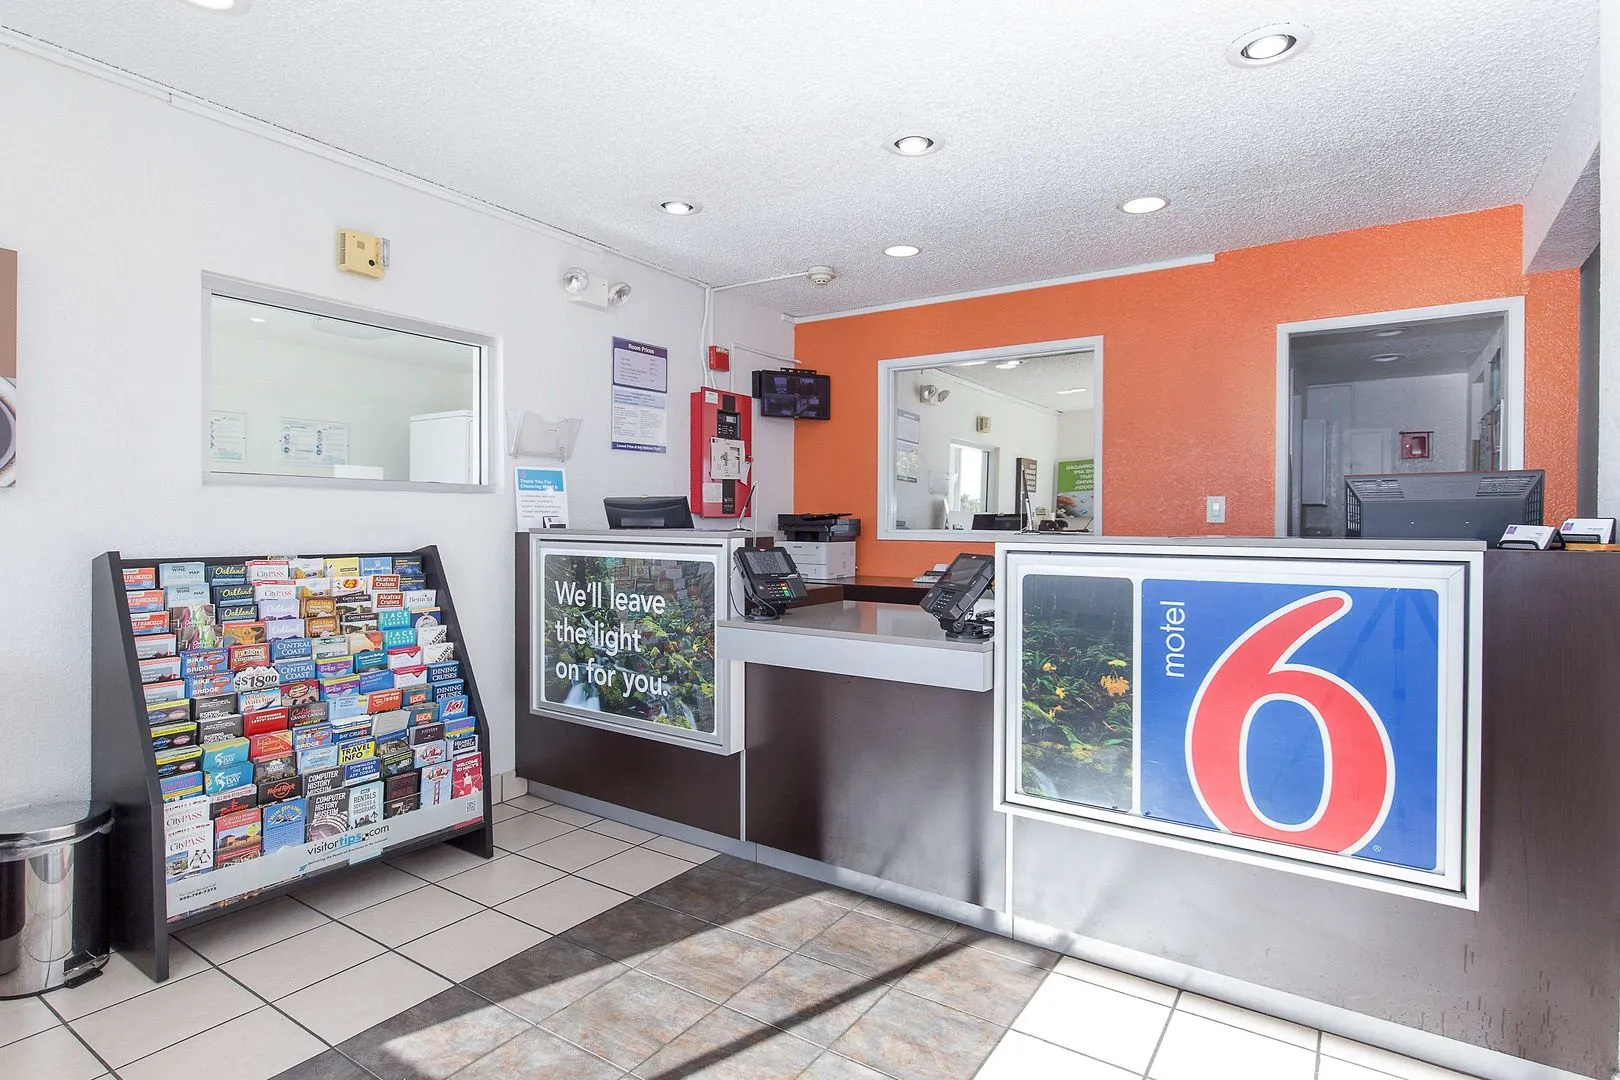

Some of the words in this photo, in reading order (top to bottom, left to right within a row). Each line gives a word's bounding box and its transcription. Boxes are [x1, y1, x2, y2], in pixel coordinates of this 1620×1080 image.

[216, 567, 245, 575] Oakland
[223, 587, 252, 596] Oakland
[555, 580, 601, 608] We'll
[610, 583, 666, 614] leave
[225, 605, 254, 616] Oakland
[430, 628, 446, 645] AZING
[555, 617, 587, 644] the
[594, 620, 642, 656] light
[278, 641, 310, 650] CENTRAL
[282, 648, 306, 656] COAST
[436, 646, 452, 662] AZING
[187, 656, 204, 664] BIKE
[281, 666, 313, 674] CENTRAL
[433, 666, 457, 674] DINING
[556, 661, 579, 680] on
[586, 658, 616, 687] for
[432, 673, 457, 681] CRUISES
[192, 687, 219, 695] BRIDGE
[437, 685, 462, 693] DINING
[437, 691, 461, 699] CRUISES
[1160, 601, 1186, 678] motel
[1185, 590, 1396, 856] 6
[341, 743, 370, 754] TRAVEL
[342, 752, 363, 762] INFO
[350, 761, 376, 770] DOWNLOAD
[456, 759, 478, 767] WELCOME
[308, 770, 339, 782] COMPUTER
[281, 783, 295, 791] Rock
[308, 780, 331, 790] HISTORY
[307, 786, 332, 795] MUSEUM
[316, 792, 346, 804] COMPUTER
[354, 792, 376, 804] RENTALS
[314, 801, 339, 812] HISTORY
[354, 801, 372, 809] SERVICES
[313, 808, 339, 820] MUSEUM
[354, 806, 376, 814] PROGRAMS
[166, 811, 202, 826] CityPASS
[170, 835, 206, 851] CityPASS
